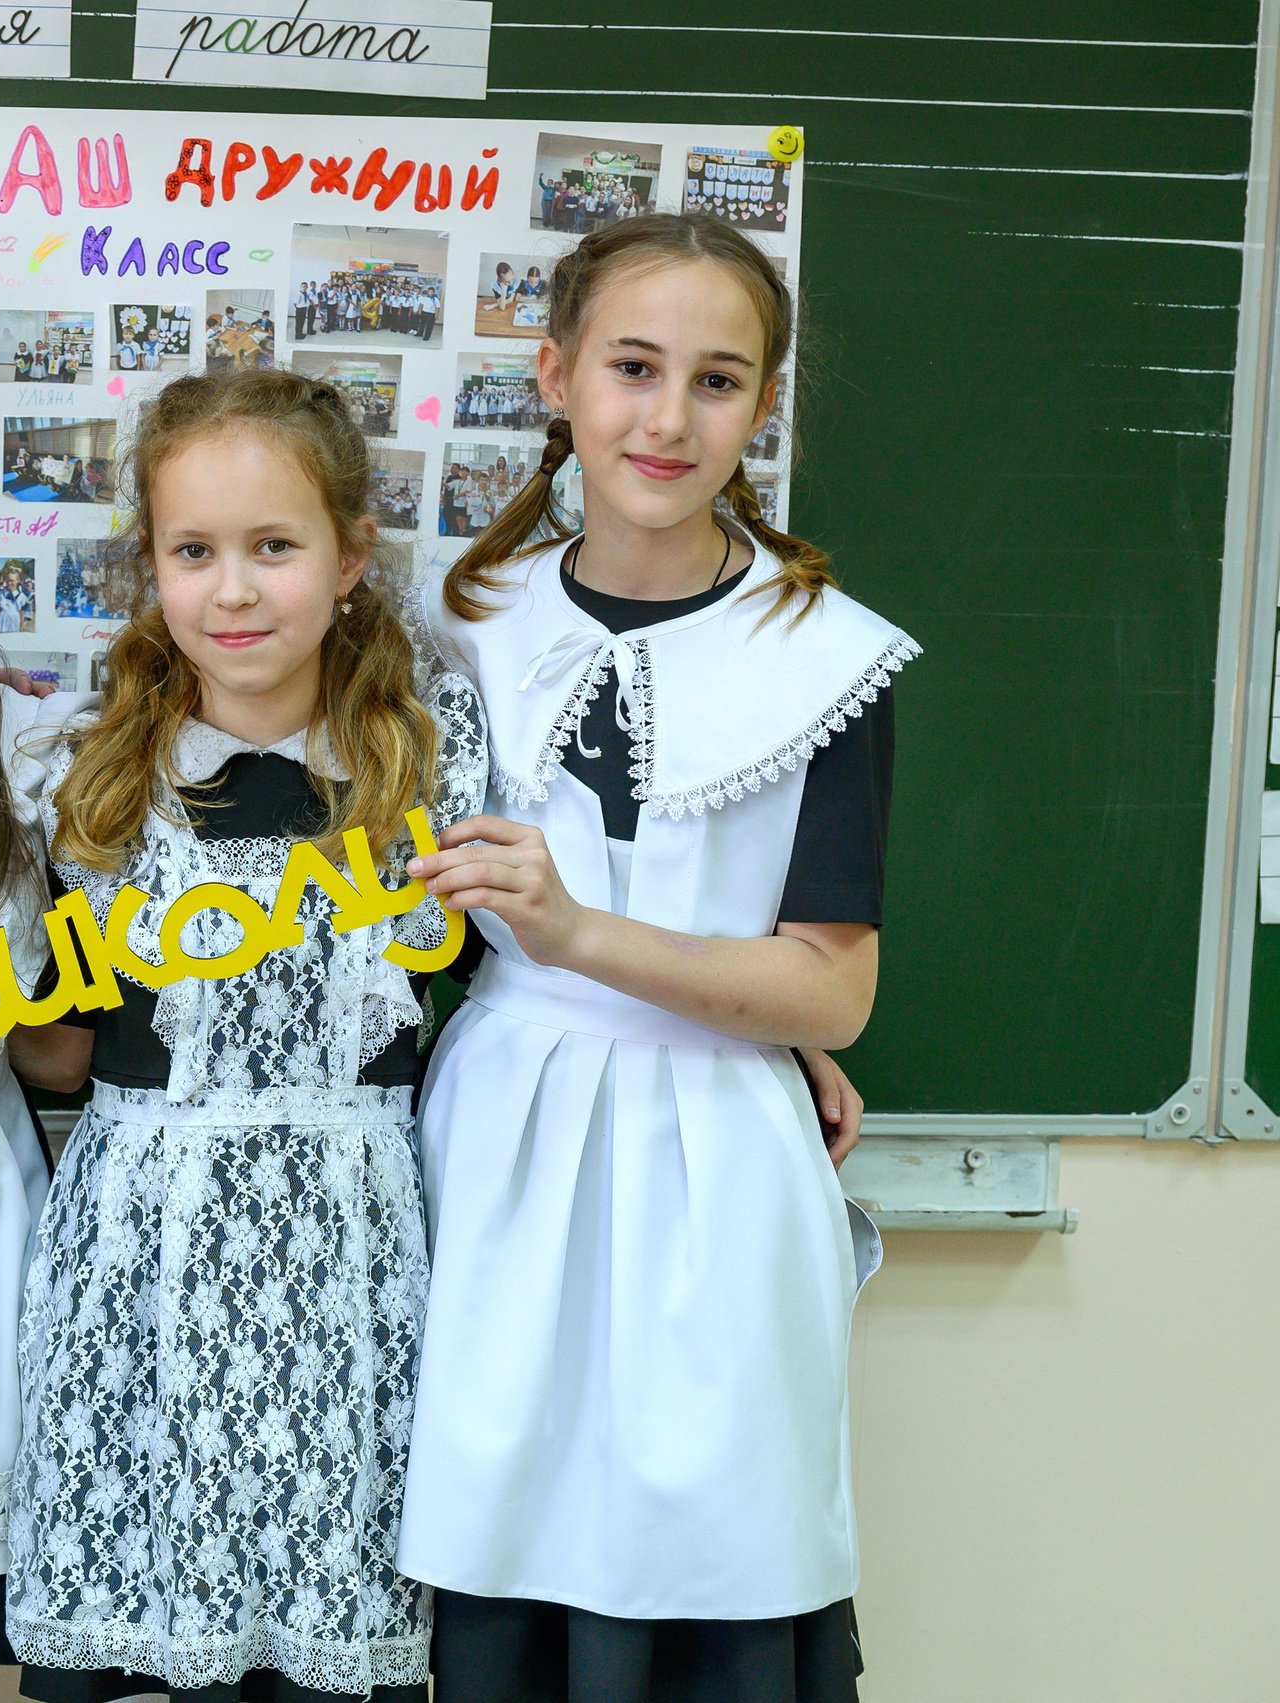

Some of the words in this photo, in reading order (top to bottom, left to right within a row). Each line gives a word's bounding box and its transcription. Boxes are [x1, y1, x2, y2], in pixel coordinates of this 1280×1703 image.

[164, 0, 430, 78] работа
[165, 138, 500, 213] ДРУЖНЫЙ
[80, 225, 230, 277] КЛАСС
[17, 388, 75, 408] УЛЬЯНА
